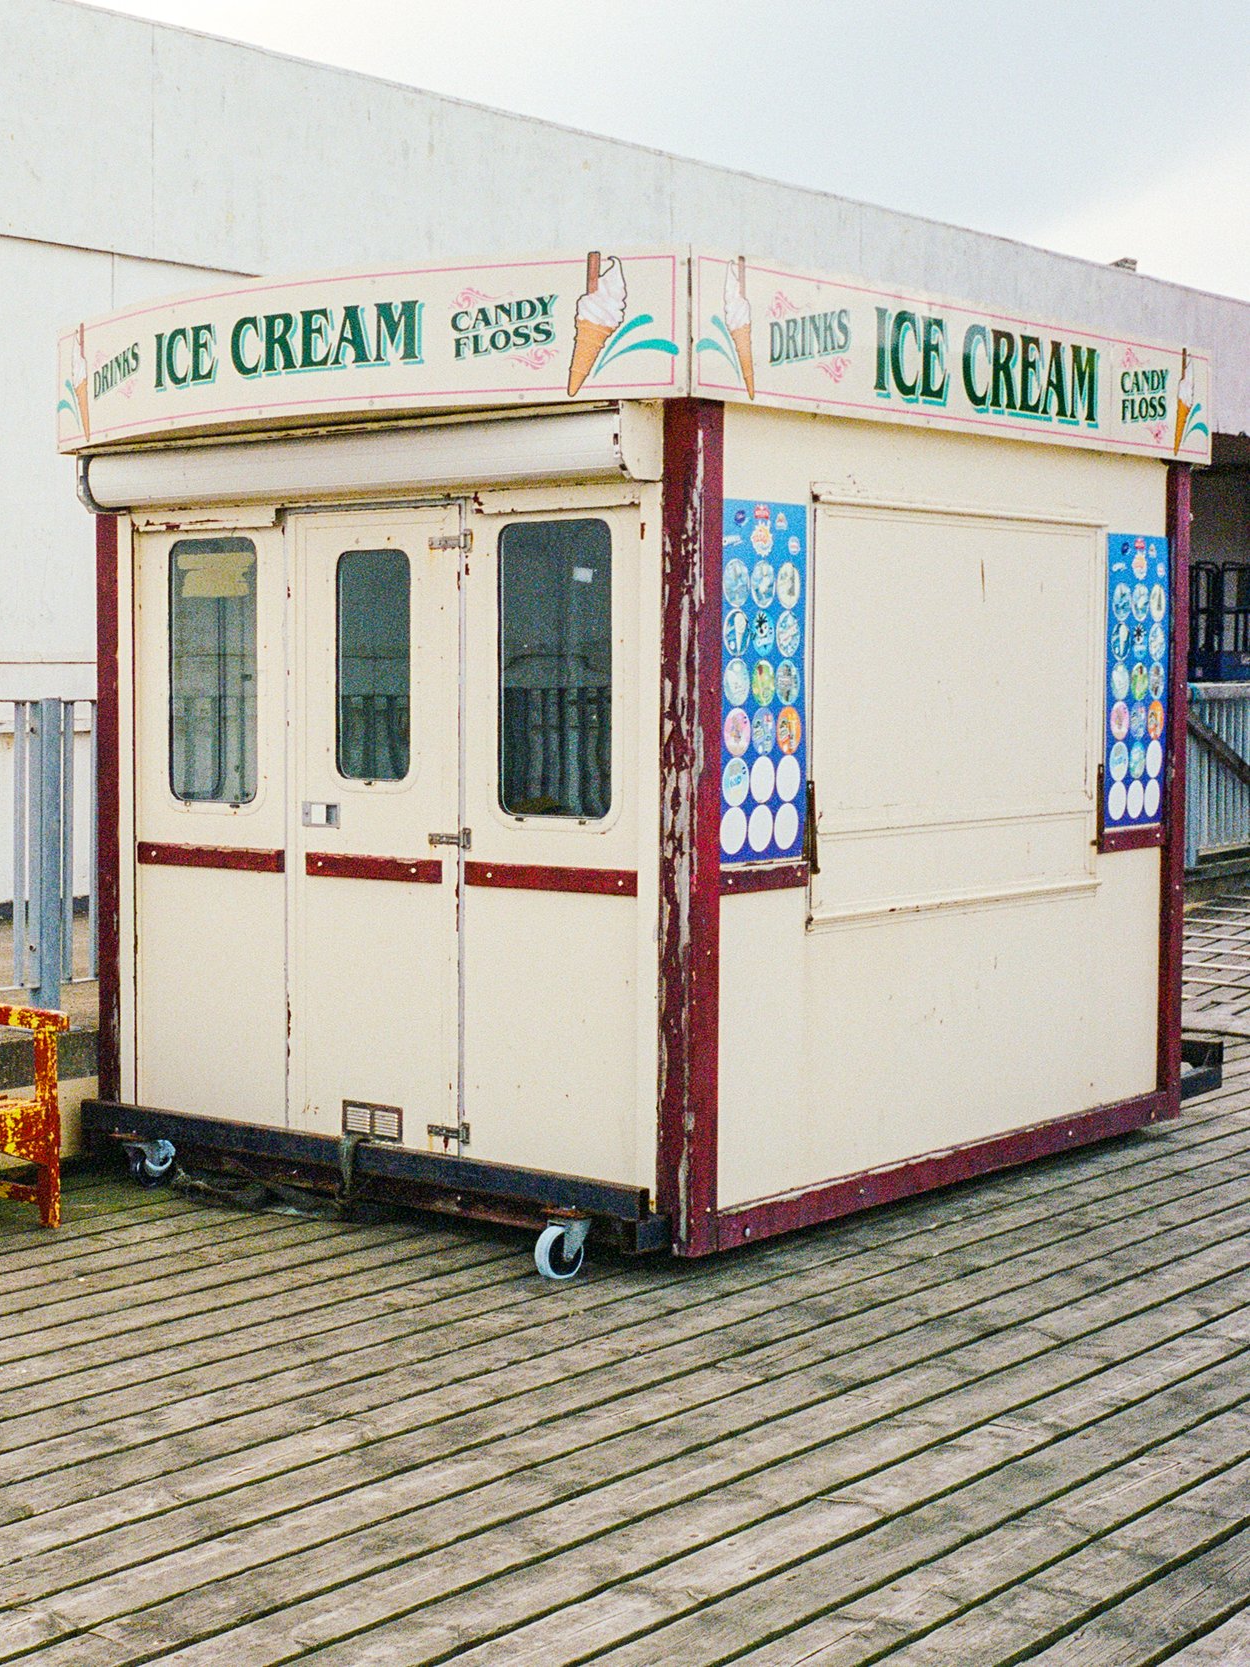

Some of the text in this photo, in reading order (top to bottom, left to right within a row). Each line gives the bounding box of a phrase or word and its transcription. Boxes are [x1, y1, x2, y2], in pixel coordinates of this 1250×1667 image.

[450, 293, 558, 334] CANDY
[769, 308, 850, 366] DRINKS
[153, 300, 426, 392] ICE CREAM
[454, 325, 556, 360] FLOSS
[93, 342, 140, 399] DRINKS
[874, 306, 1099, 429] ICE CREAM
[1120, 368, 1169, 396] CANDY
[1120, 395, 1168, 424] FLOSS
